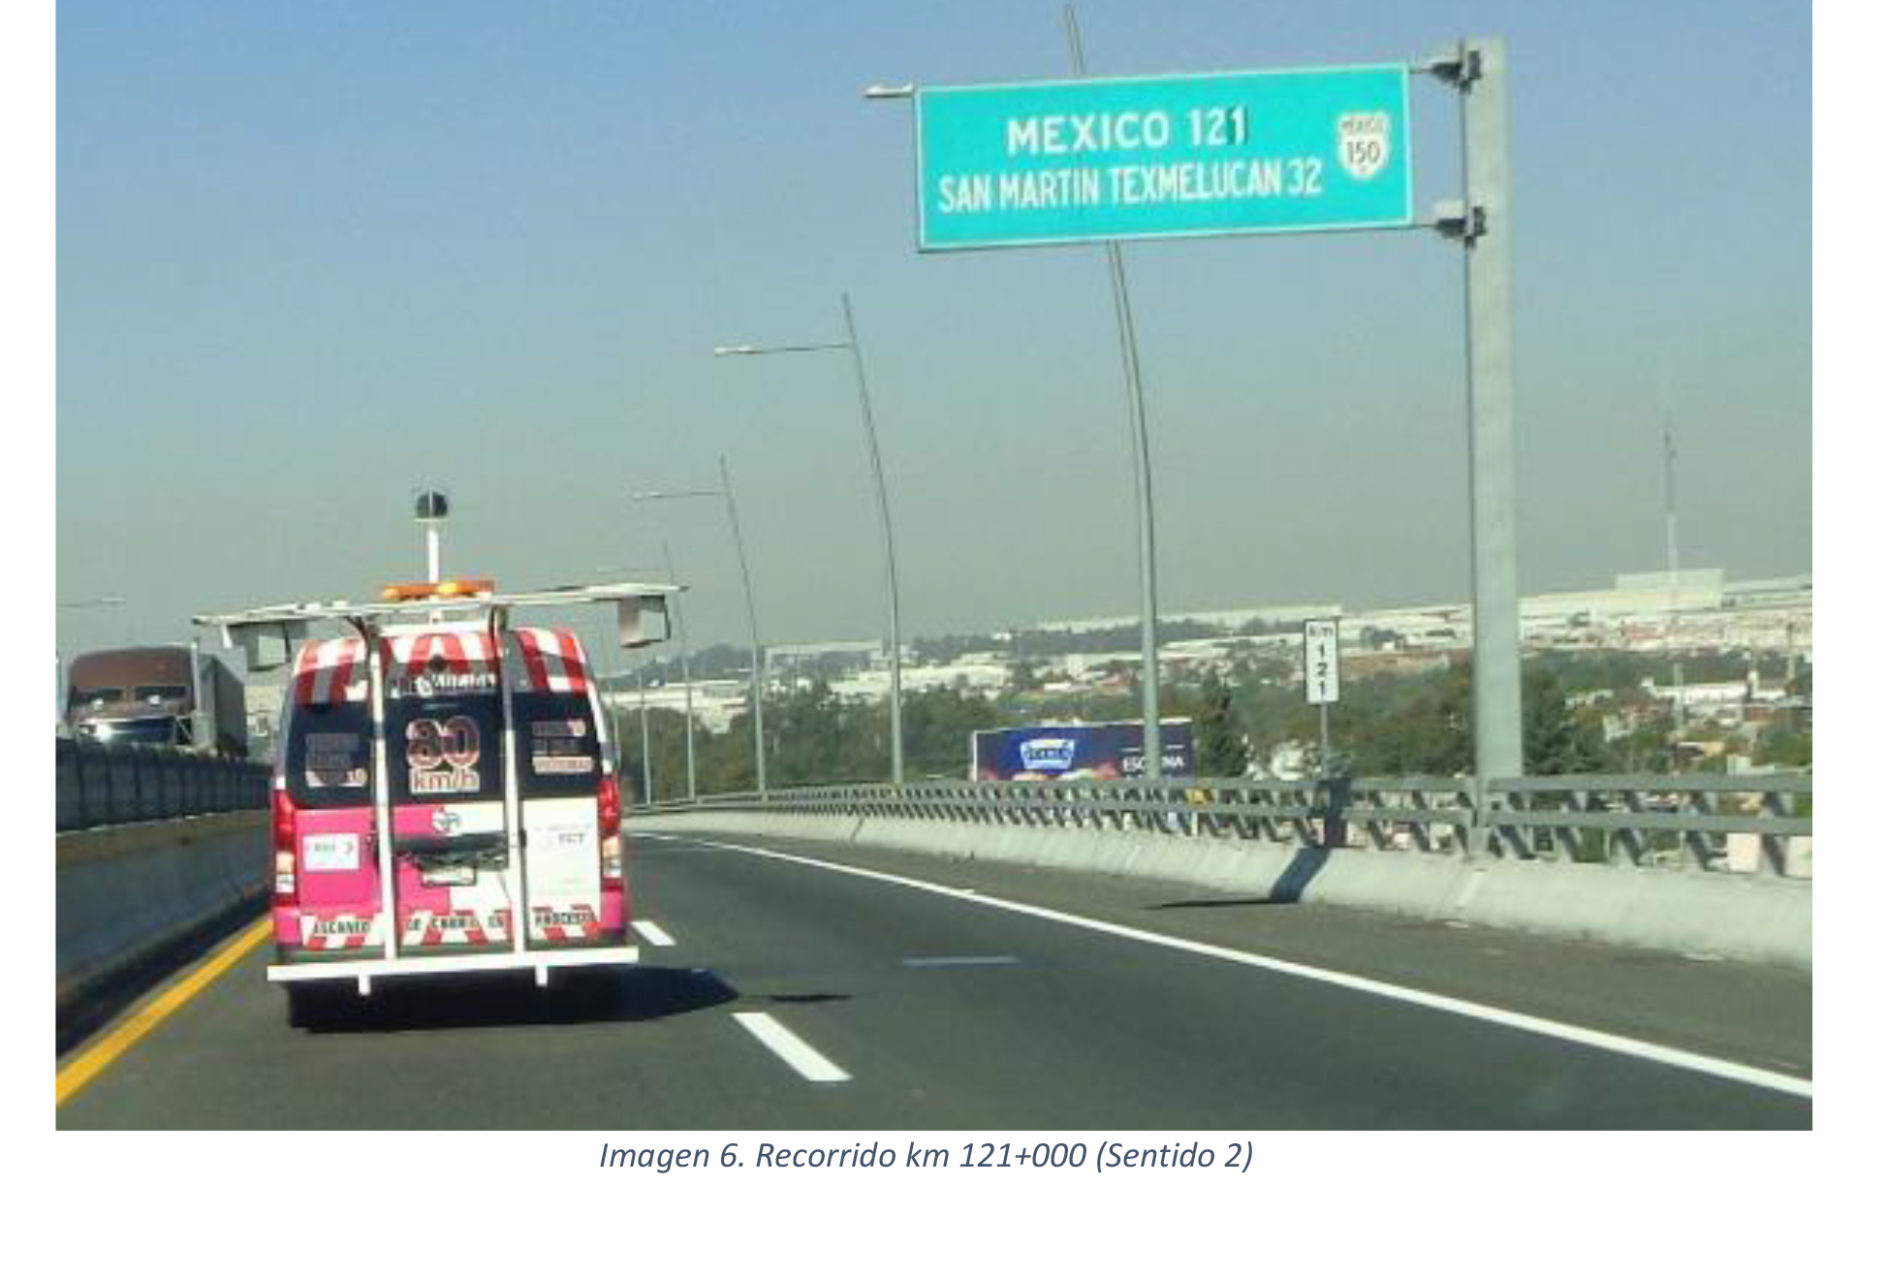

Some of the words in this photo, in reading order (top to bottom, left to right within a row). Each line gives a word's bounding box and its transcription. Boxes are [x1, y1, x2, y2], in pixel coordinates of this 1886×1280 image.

[1007, 111, 1170, 156] MEXICO
[1188, 106, 1247, 147] 121
[1346, 140, 1381, 166] 150
[938, 174, 992, 214] SAN
[998, 168, 1100, 210] MARTIN
[1107, 157, 1281, 206] TEXMELUCAN
[1286, 156, 1323, 196] 32
